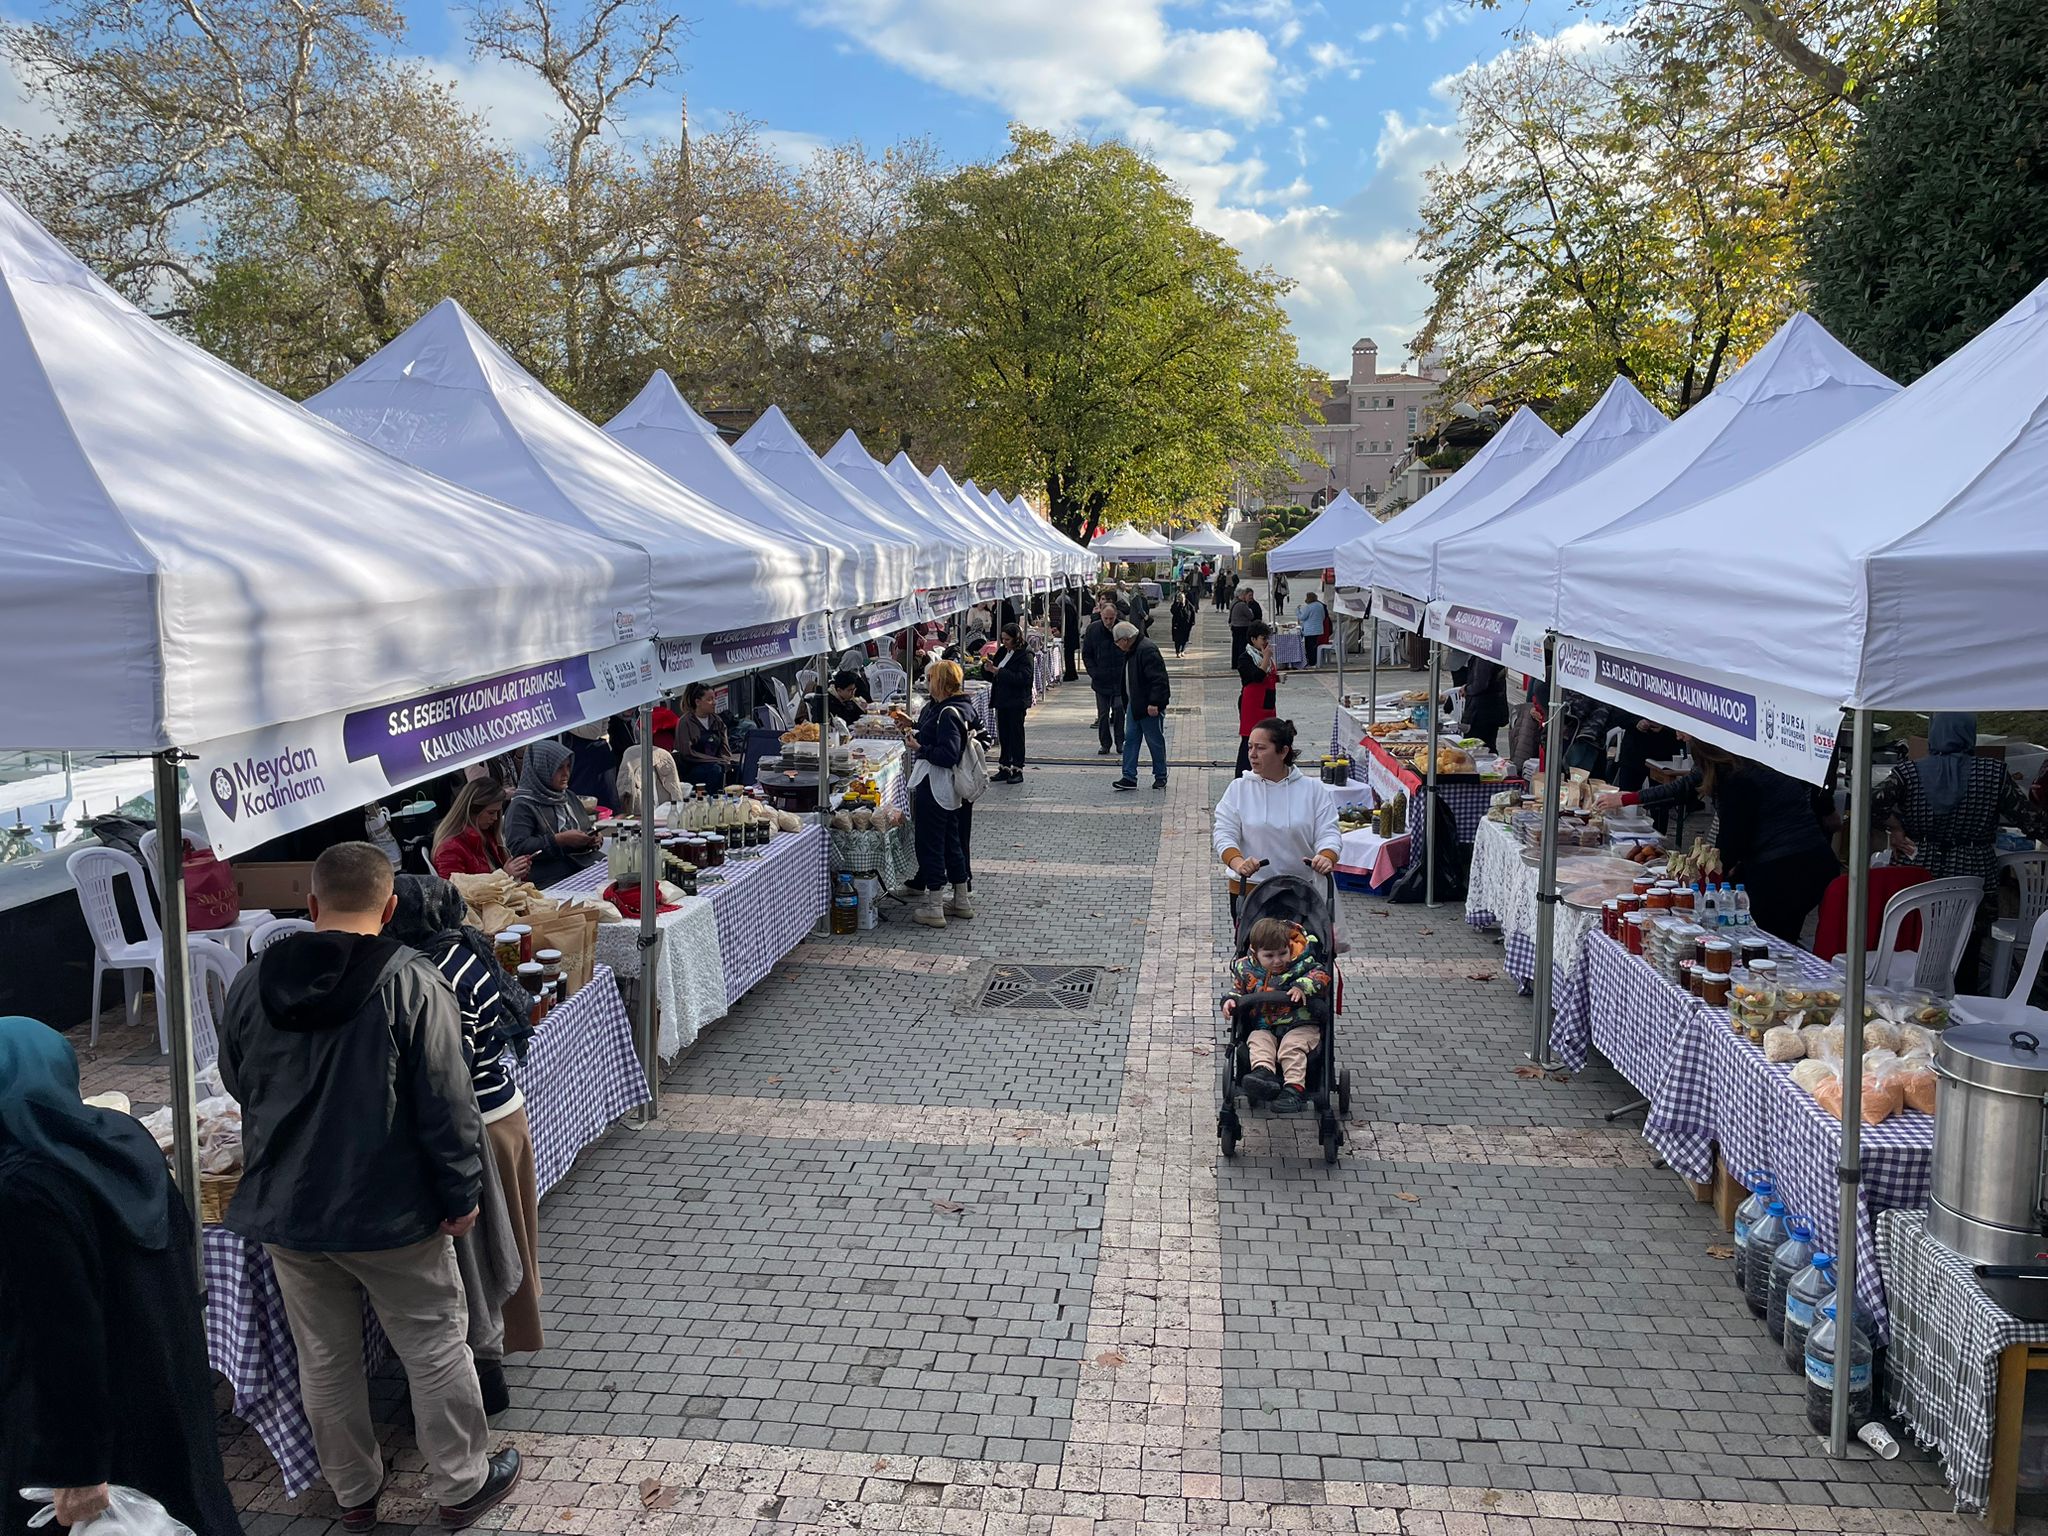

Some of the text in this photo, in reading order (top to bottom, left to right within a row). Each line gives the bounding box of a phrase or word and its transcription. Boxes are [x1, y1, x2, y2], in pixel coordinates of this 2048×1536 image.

[666, 640, 692, 660] Meydan
[1566, 644, 1591, 665] Meydan
[614, 660, 635, 674] BURSA
[1564, 660, 1590, 679] Kadınların
[388, 668, 567, 737] S.S. ESEBEY KADINLARI TARIMSAL
[1601, 660, 1748, 726] S.S. ATLAS KÖY TARIMSAL KALKINMA KOOP.
[420, 697, 558, 763] KALKINMA KOOPERATİFİ
[1781, 711, 1805, 731] BURSA
[233, 746, 318, 791] Meydan
[242, 775, 326, 818] Kadınların
